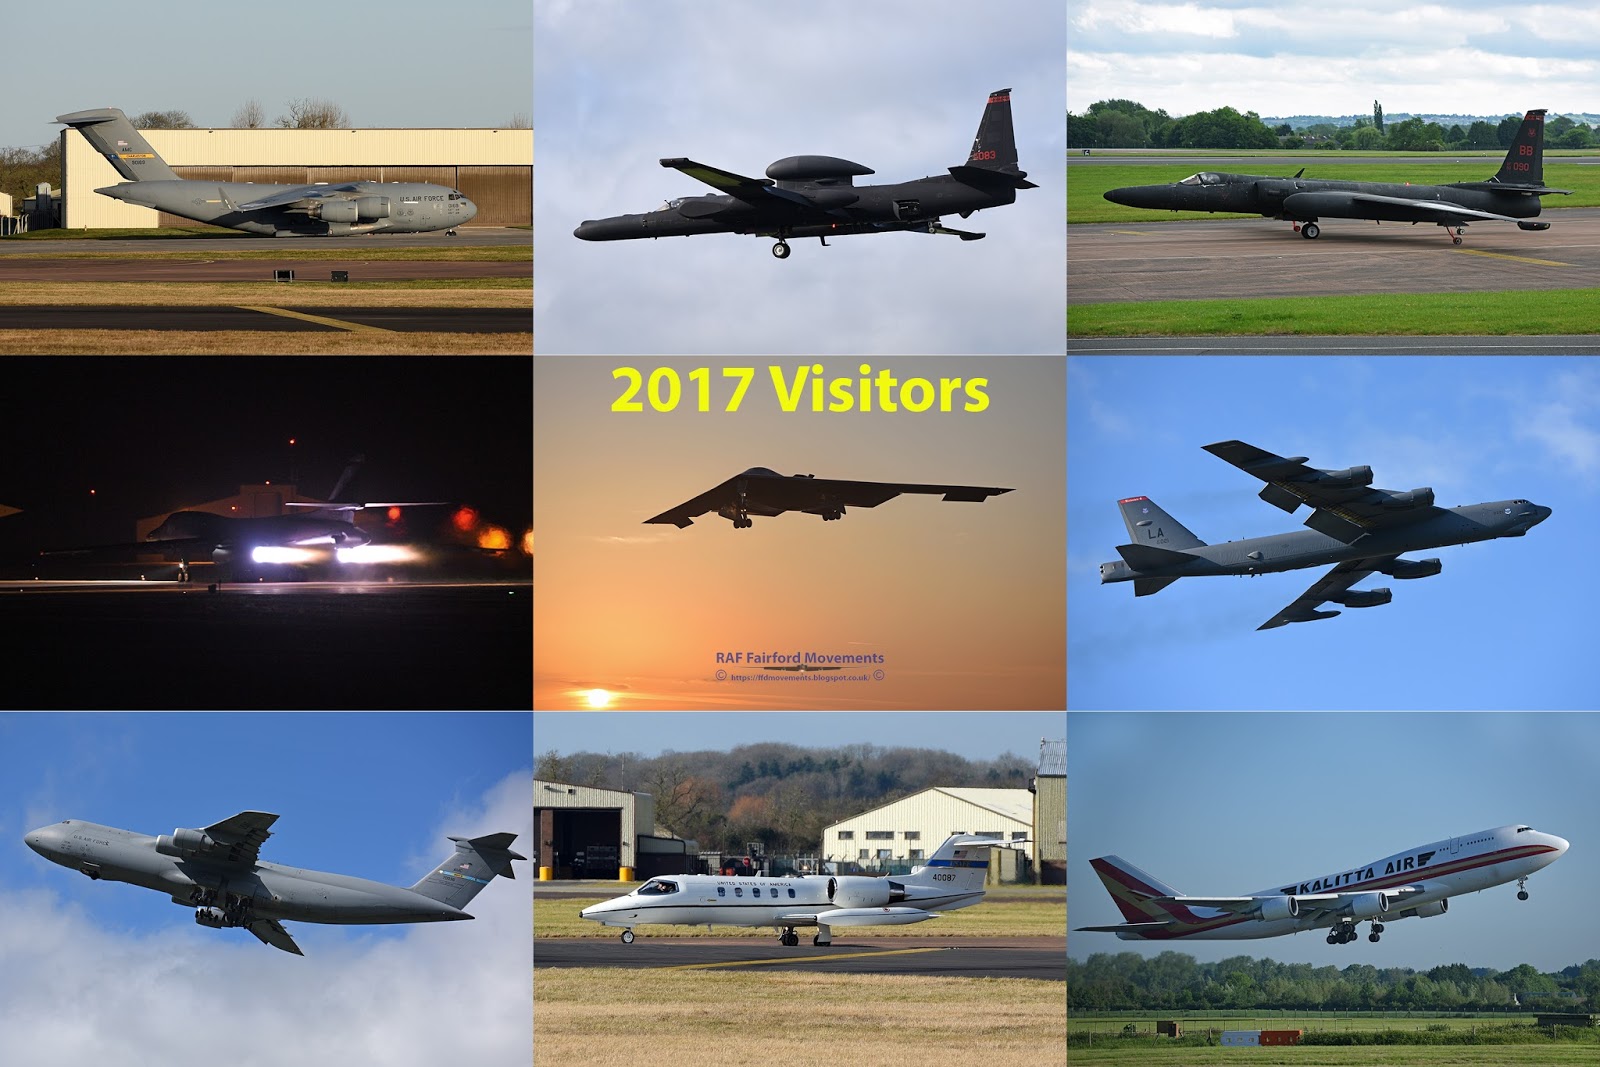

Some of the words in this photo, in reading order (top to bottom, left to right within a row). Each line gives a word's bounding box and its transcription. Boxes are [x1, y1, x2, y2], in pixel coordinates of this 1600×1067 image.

[1520, 145, 1533, 156] BB
[1148, 527, 1164, 539] LA
[932, 873, 956, 882] 40087
[1300, 868, 1375, 894] KALITTA
[1385, 856, 1414, 875] AIR
